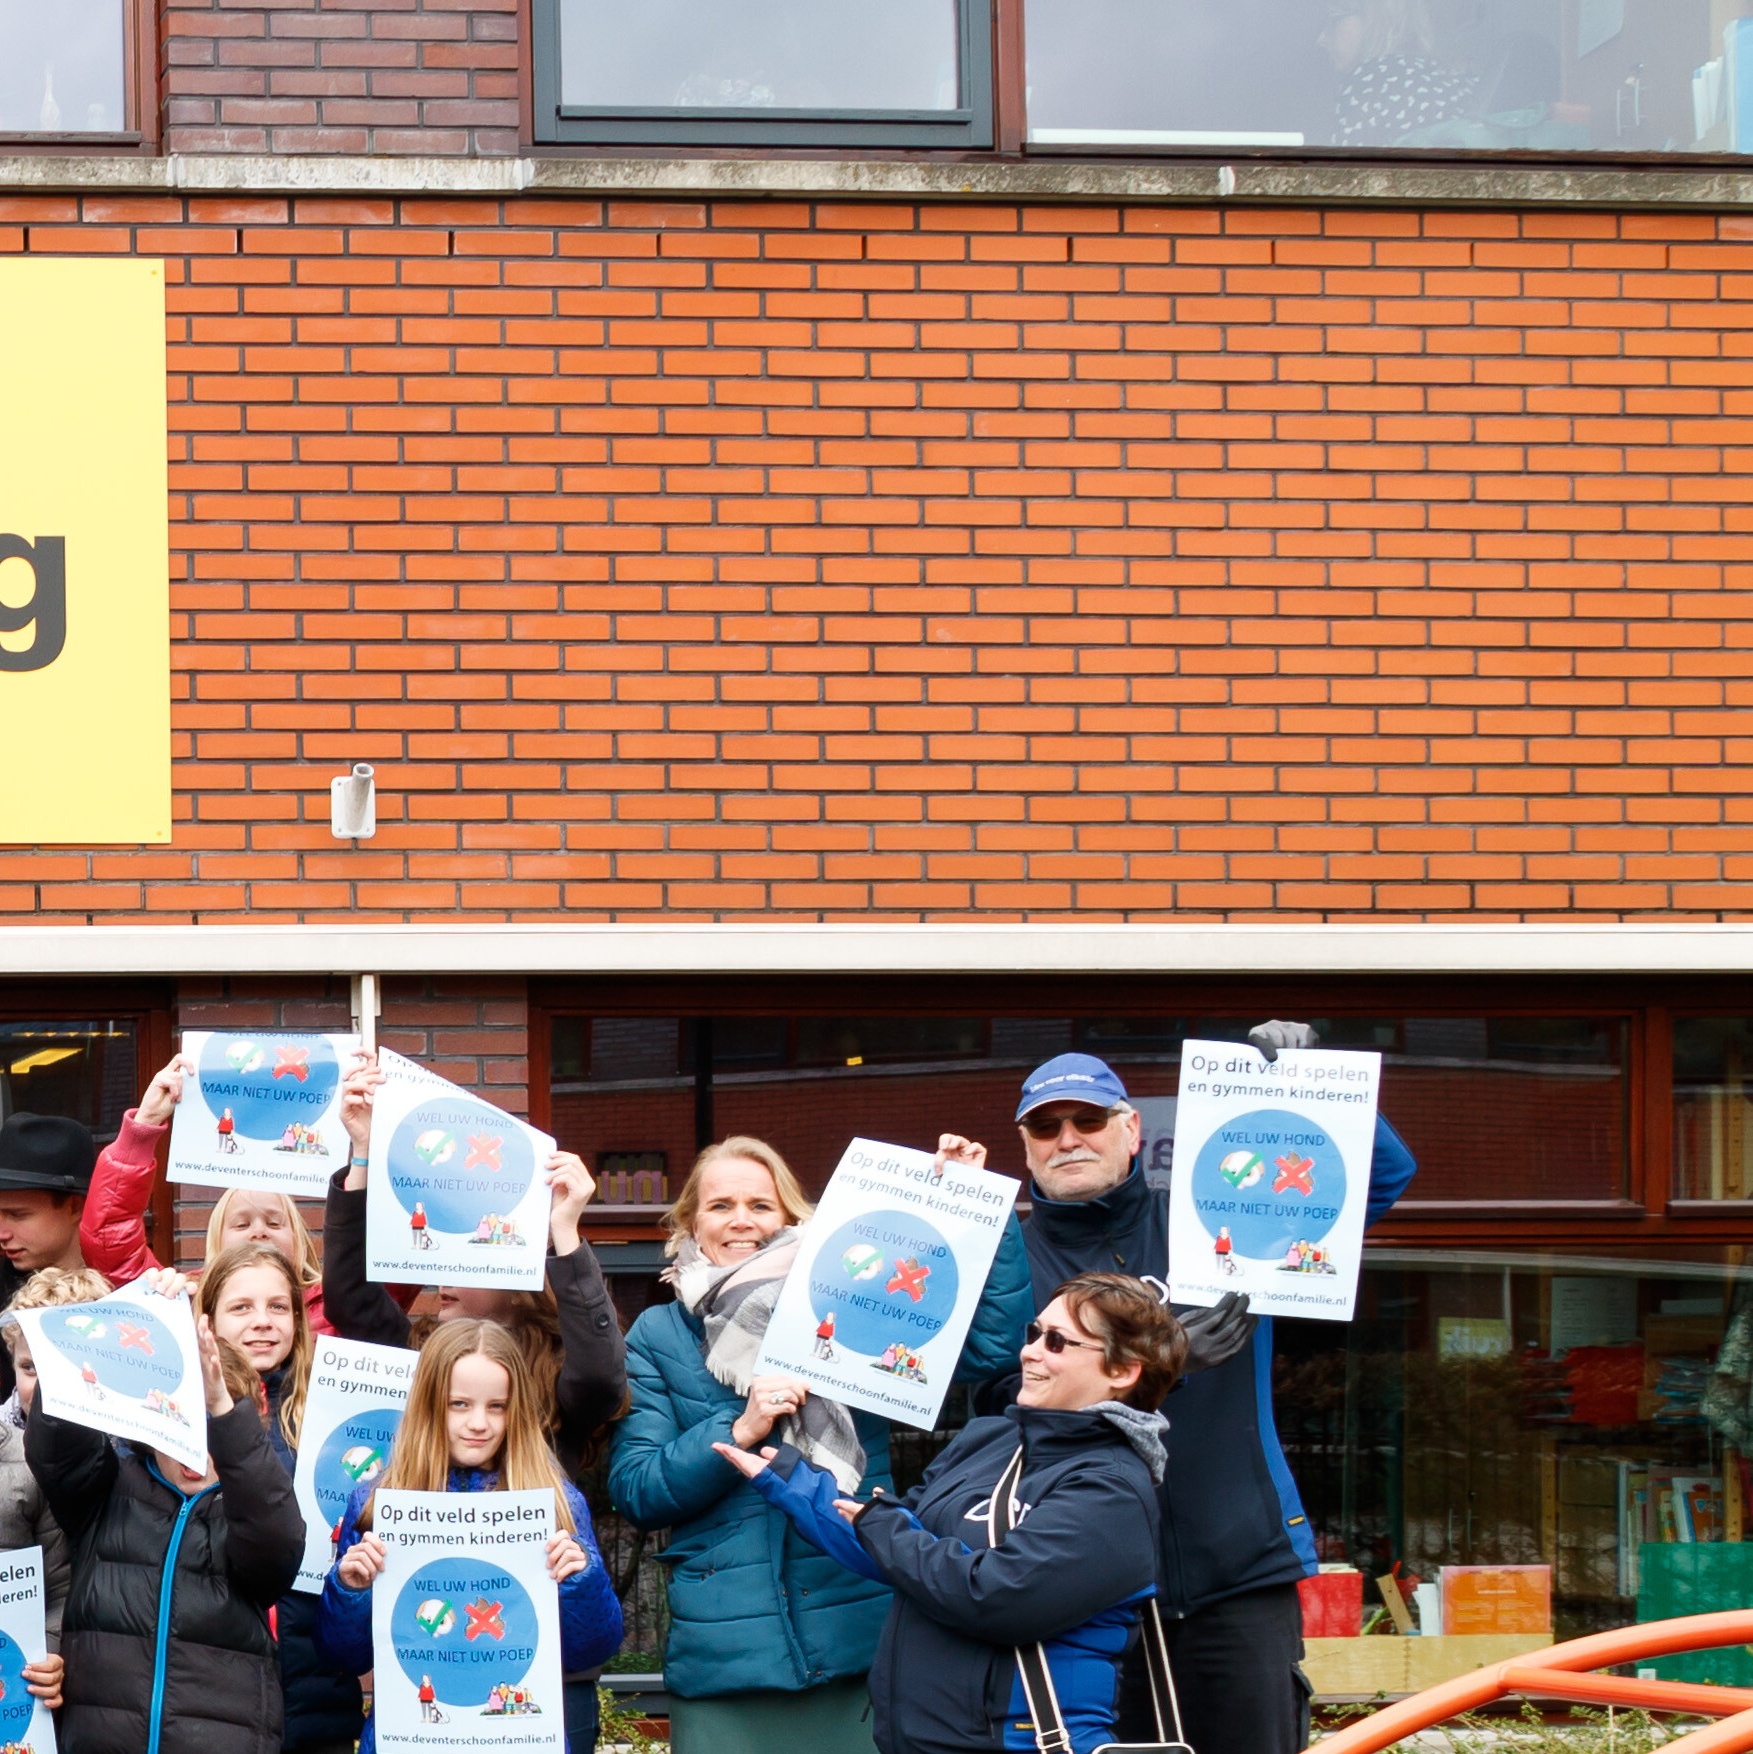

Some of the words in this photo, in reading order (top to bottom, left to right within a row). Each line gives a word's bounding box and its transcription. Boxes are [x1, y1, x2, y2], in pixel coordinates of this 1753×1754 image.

[1191, 1055, 1219, 1075] Op
[1225, 1058, 1252, 1074] dit
[1257, 1057, 1298, 1078] veld
[1304, 1065, 1369, 1083] spelen
[202, 1081, 239, 1096] MAAR
[242, 1086, 272, 1099] NIET
[273, 1088, 297, 1102] UW
[298, 1091, 330, 1105] POEP
[1187, 1082, 1207, 1092] en
[1212, 1083, 1284, 1097] gymmen
[1289, 1086, 1369, 1103] kinderen!
[1221, 1131, 1252, 1144] WEL
[1255, 1132, 1280, 1144] UW
[1284, 1133, 1325, 1146] HOND
[850, 1151, 874, 1170] Op
[876, 1158, 901, 1175] dit
[905, 1167, 944, 1187] veld
[946, 1180, 1004, 1207] spelen
[858, 1178, 922, 1204] gymmen
[925, 1194, 999, 1228] kinderen!
[764, 1356, 932, 1416] www.deventerschoonfamilie.nl
[380, 1504, 403, 1525] Op
[408, 1506, 431, 1522] dit
[436, 1507, 475, 1524] veld
[482, 1505, 545, 1527] spelen
[378, 1531, 395, 1542] en
[399, 1533, 465, 1546] gymmen
[469, 1528, 547, 1545] kinderen!
[413, 1579, 441, 1592] WEL
[443, 1580, 466, 1592] UW
[470, 1576, 511, 1592] HOND
[396, 1647, 435, 1661] MAAR
[438, 1650, 467, 1663] NIET
[470, 1650, 495, 1663] UW
[498, 1647, 534, 1661] POEP
[381, 1733, 556, 1745] www.deventerschoonfamilie.nl
